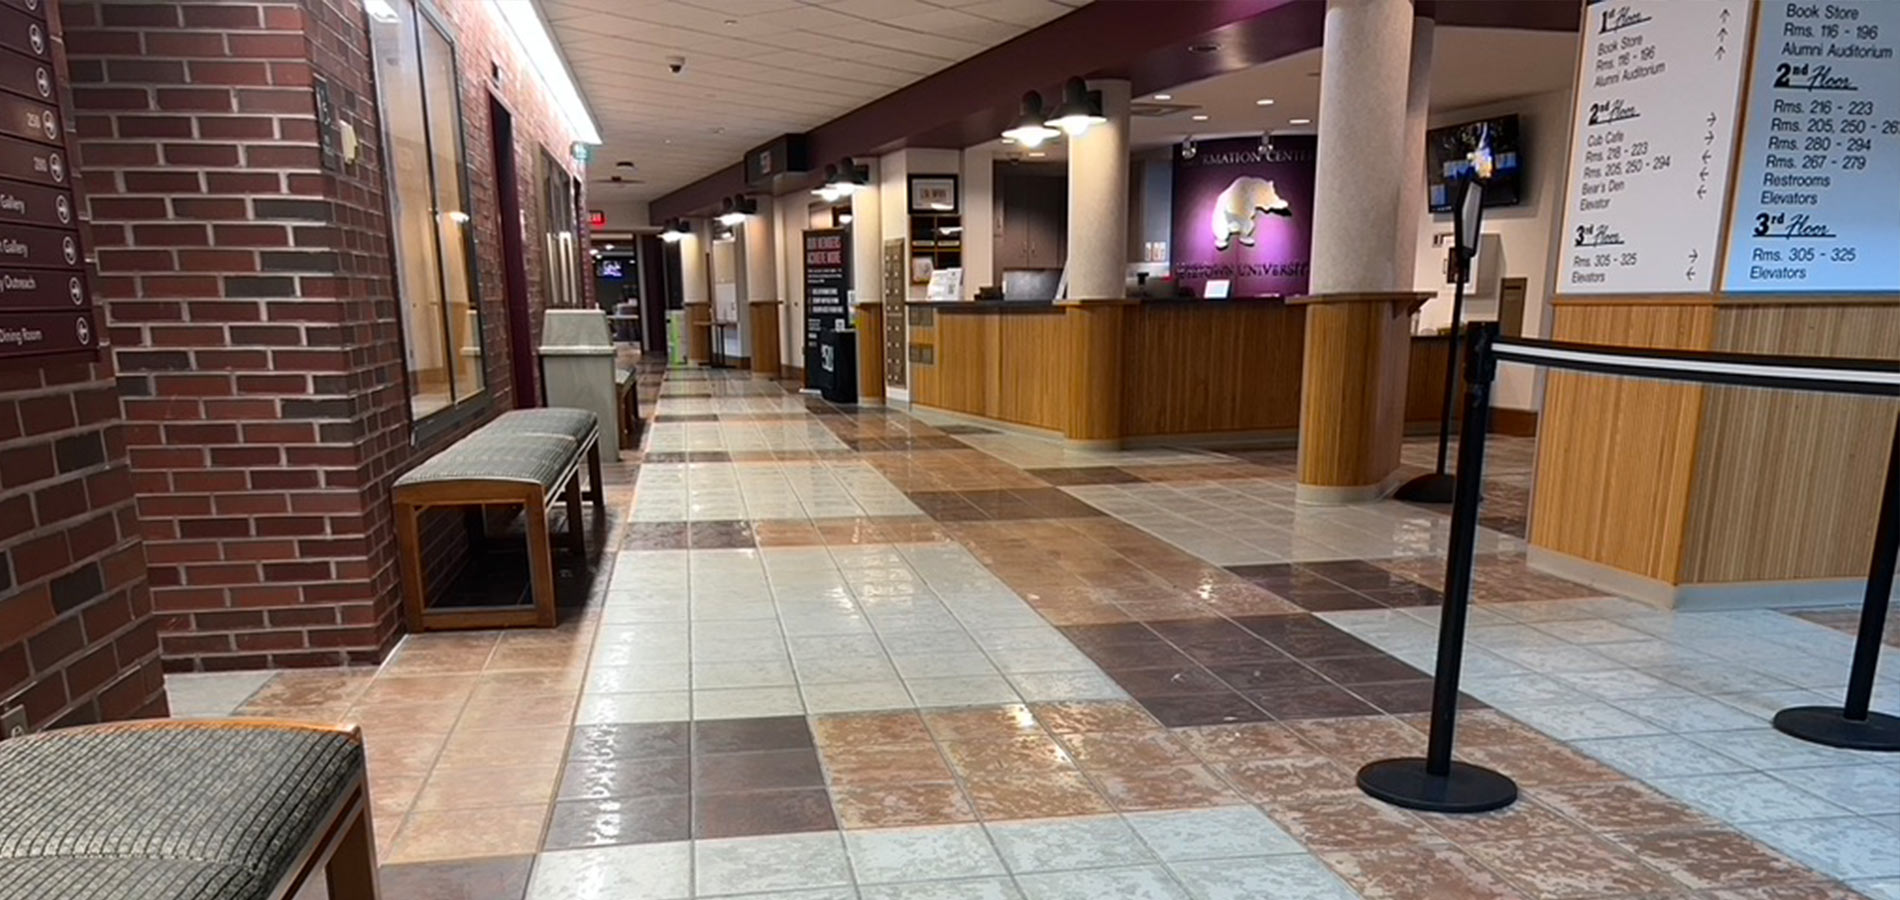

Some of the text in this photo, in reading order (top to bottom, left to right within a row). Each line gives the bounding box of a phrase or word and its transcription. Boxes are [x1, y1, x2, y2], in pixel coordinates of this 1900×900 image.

[1599, 6, 1642, 34] 1st Floor
[1786, 3, 1859, 20] Book Store
[1783, 22, 1814, 38] Rms.
[1821, 24, 1839, 39] 116
[1856, 25, 1878, 40] 196
[1597, 35, 1643, 56] Book Store
[1781, 41, 1893, 59] Alumni Auditorium
[1593, 62, 1665, 88] Alumni Auditorium
[1774, 63, 1853, 91] 2nd Floor
[1588, 99, 1636, 126] 2nd Floor
[1773, 99, 1804, 115] Rms.
[1810, 100, 1832, 115] 216
[1848, 101, 1873, 116] 223
[1771, 117, 1802, 133] Rms.
[1840, 119, 1866, 134] 250
[1882, 120, 1900, 135] 26
[1587, 131, 1625, 148] Cub Cafe
[1768, 136, 1799, 151] Rms.
[1804, 137, 1831, 151] 280
[1847, 138, 1872, 152] 294
[1631, 142, 1649, 157] 223
[1625, 159, 1643, 174] 250
[1653, 155, 1671, 171] 294
[1766, 154, 1797, 169] Rms.
[1802, 155, 1827, 169] 267
[1842, 156, 1867, 170] 279
[1582, 179, 1625, 195] Bear's Den
[1763, 172, 1831, 187] Restrooms
[0, 193, 25, 215] Gallery
[1580, 198, 1610, 211] Elevator
[1760, 190, 1818, 206] Elevators
[1754, 212, 1830, 240] 3rd Floor
[1575, 224, 1594, 246] 3rd
[3, 238, 28, 258] Gallery
[1752, 248, 1783, 262] Rms.
[1788, 248, 1815, 262] 305
[1830, 248, 1857, 262] 325
[1594, 254, 1611, 267] 305
[1620, 252, 1637, 266] 325
[1571, 271, 1605, 284] Elevators
[1750, 266, 1806, 280] Elevators
[4, 275, 37, 290] Outreach
[21, 326, 43, 342] Room
